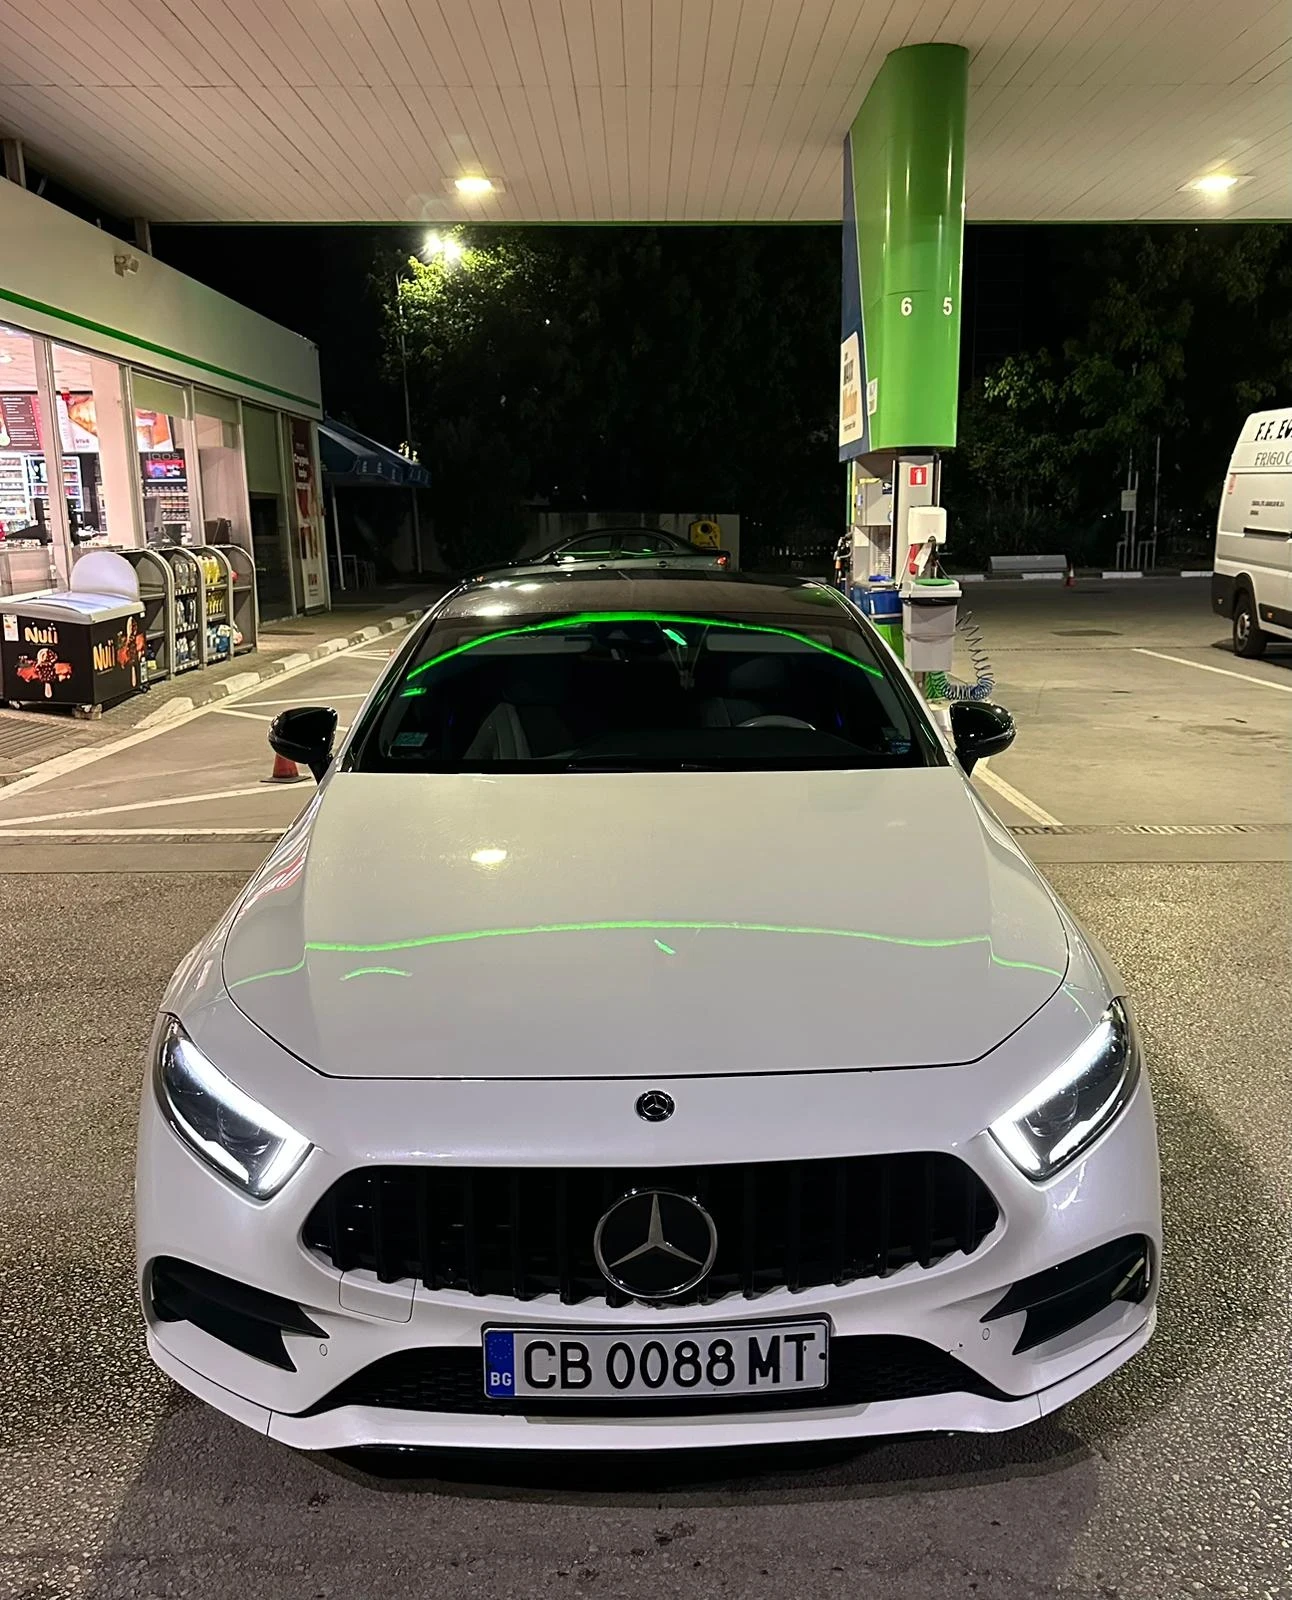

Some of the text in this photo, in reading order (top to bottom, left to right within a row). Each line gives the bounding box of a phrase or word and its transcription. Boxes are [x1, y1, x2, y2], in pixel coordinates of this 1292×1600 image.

[900, 296, 913, 317] 6
[942, 296, 953, 316] 5
[1254, 421, 1275, 441] F.F.
[148, 452, 180, 461] IQOS
[1254, 451, 1285, 467] FRIGO
[24, 626, 59, 644] Nuii
[93, 640, 115, 670] Nuii
[523, 1332, 816, 1390] CB 0088 MT
[490, 1371, 512, 1387] BG
